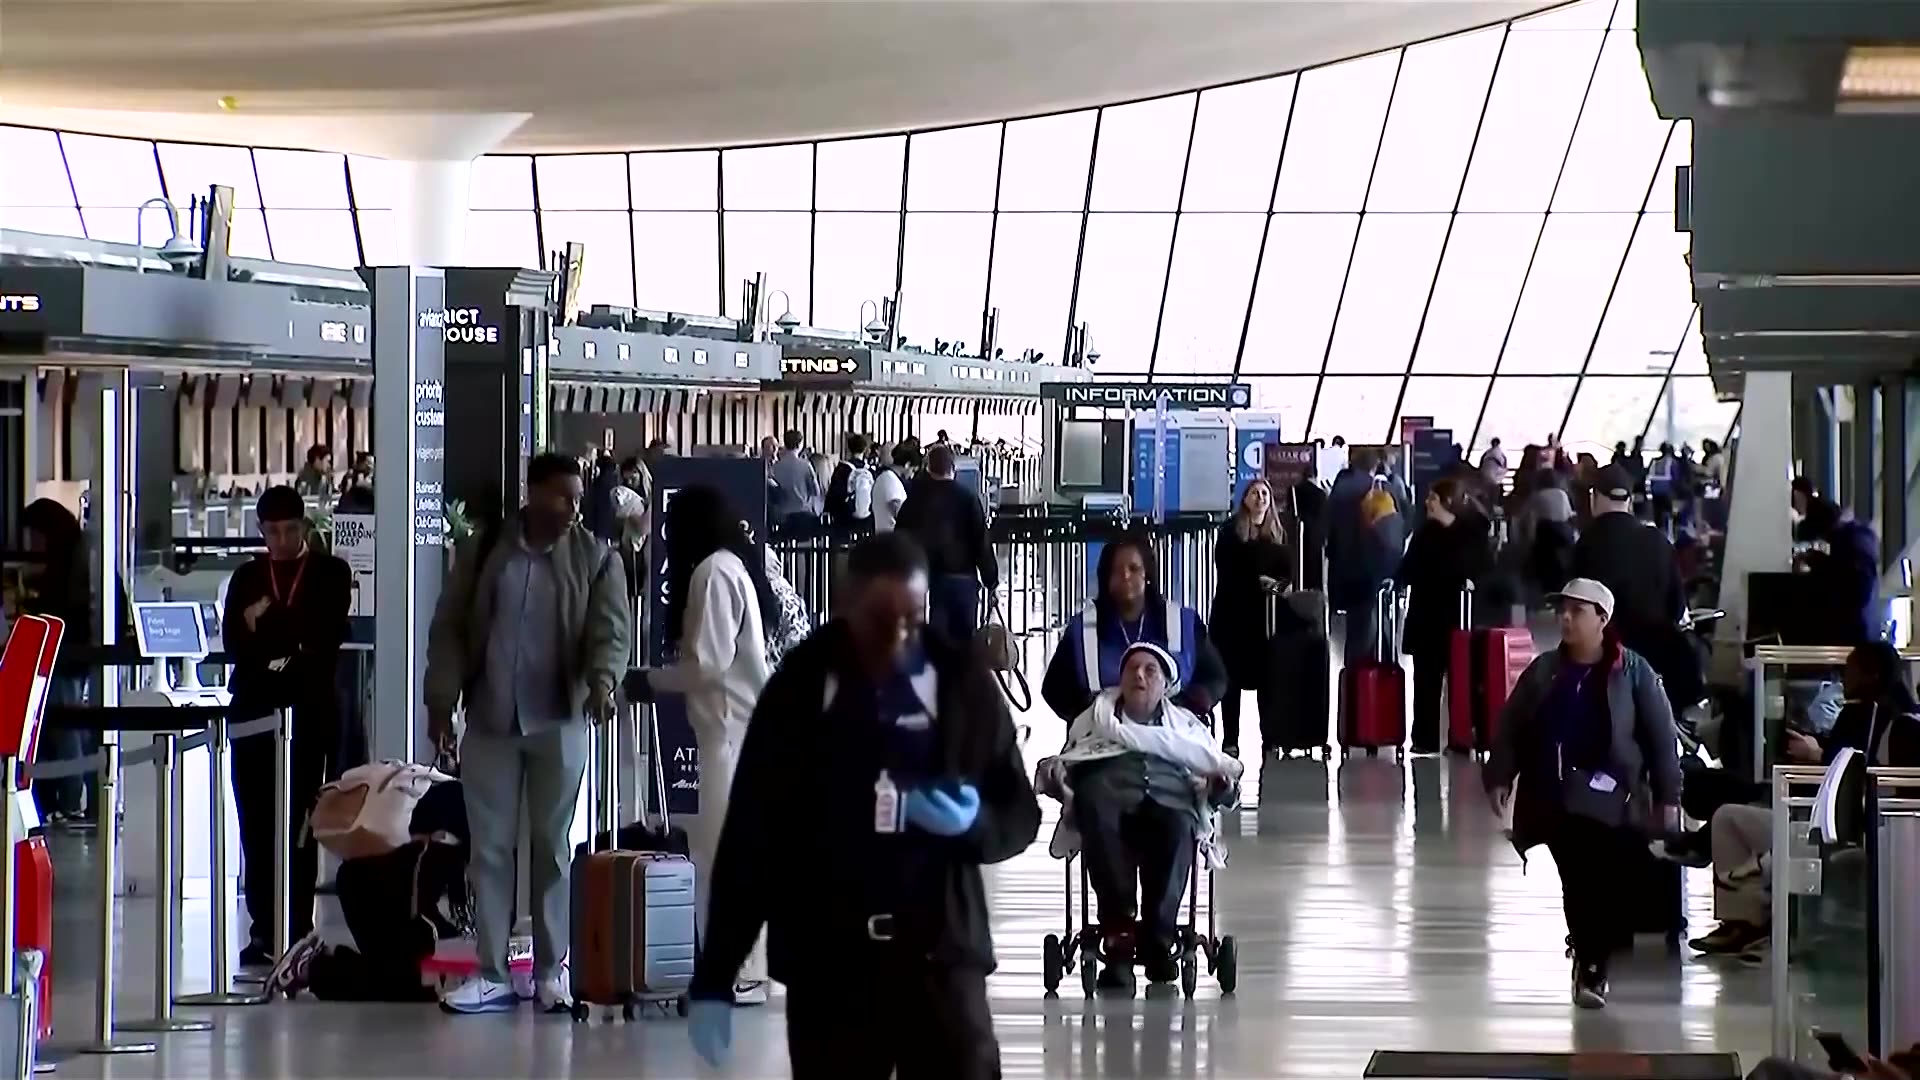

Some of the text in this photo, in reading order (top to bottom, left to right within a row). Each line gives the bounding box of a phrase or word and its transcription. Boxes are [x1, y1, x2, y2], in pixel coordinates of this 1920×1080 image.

[443, 326, 498, 343] OUSE
[1066, 387, 1227, 402] INFORMATION
[335, 521, 364, 530] NEED A
[335, 539, 360, 547] PASS?
